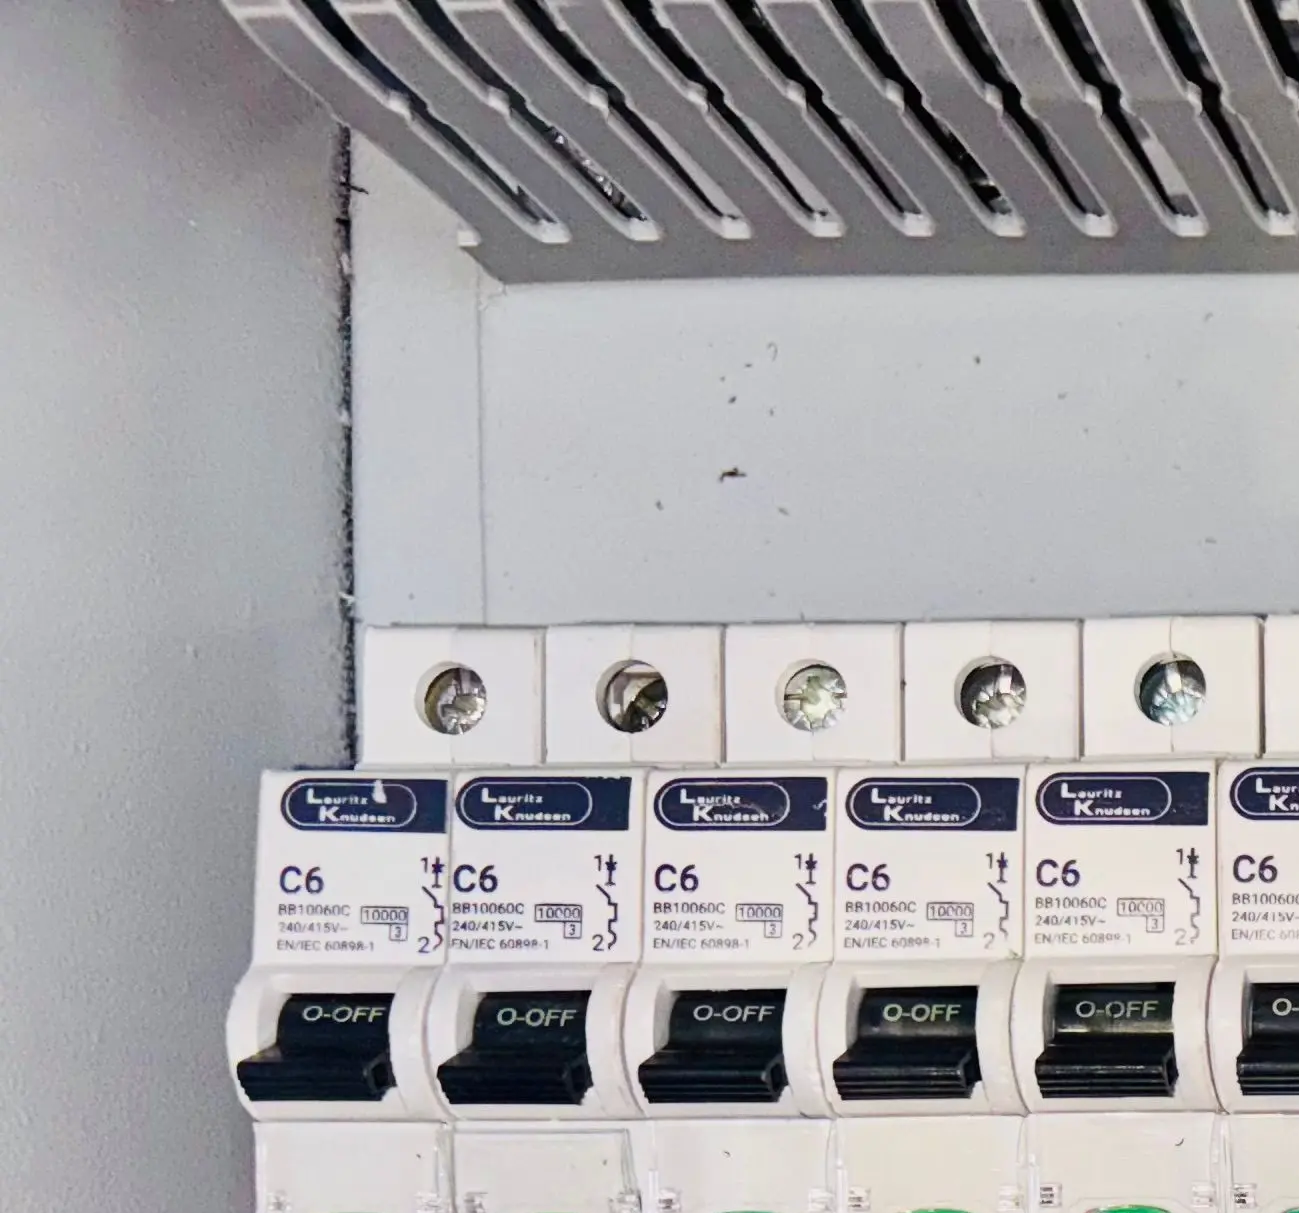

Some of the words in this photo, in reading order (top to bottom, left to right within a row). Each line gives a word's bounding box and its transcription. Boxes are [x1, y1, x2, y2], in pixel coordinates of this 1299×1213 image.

[1037, 859, 1080, 887] C6
[1233, 855, 1277, 883] C6
[280, 866, 324, 893] C6
[453, 865, 497, 892] C6
[655, 864, 698, 891] C6
[847, 864, 890, 891] C6
[278, 904, 349, 915] BB10060C
[453, 903, 524, 914] BB10060C
[654, 902, 724, 913] BB10060C
[846, 901, 916, 912] BB10060C
[1036, 897, 1106, 908] BB10060C
[1122, 902, 1164, 912] 10000
[366, 910, 406, 921] 10000
[539, 909, 580, 918] 10000
[741, 908, 782, 917] 10000
[932, 907, 973, 917] 10000
[302, 1006, 385, 1022] O-OFF
[497, 1008, 576, 1026] O-OFF
[694, 1005, 774, 1021] O-OFF
[883, 1004, 960, 1024] O-OFF
[1076, 1001, 1158, 1021] O-OFF
